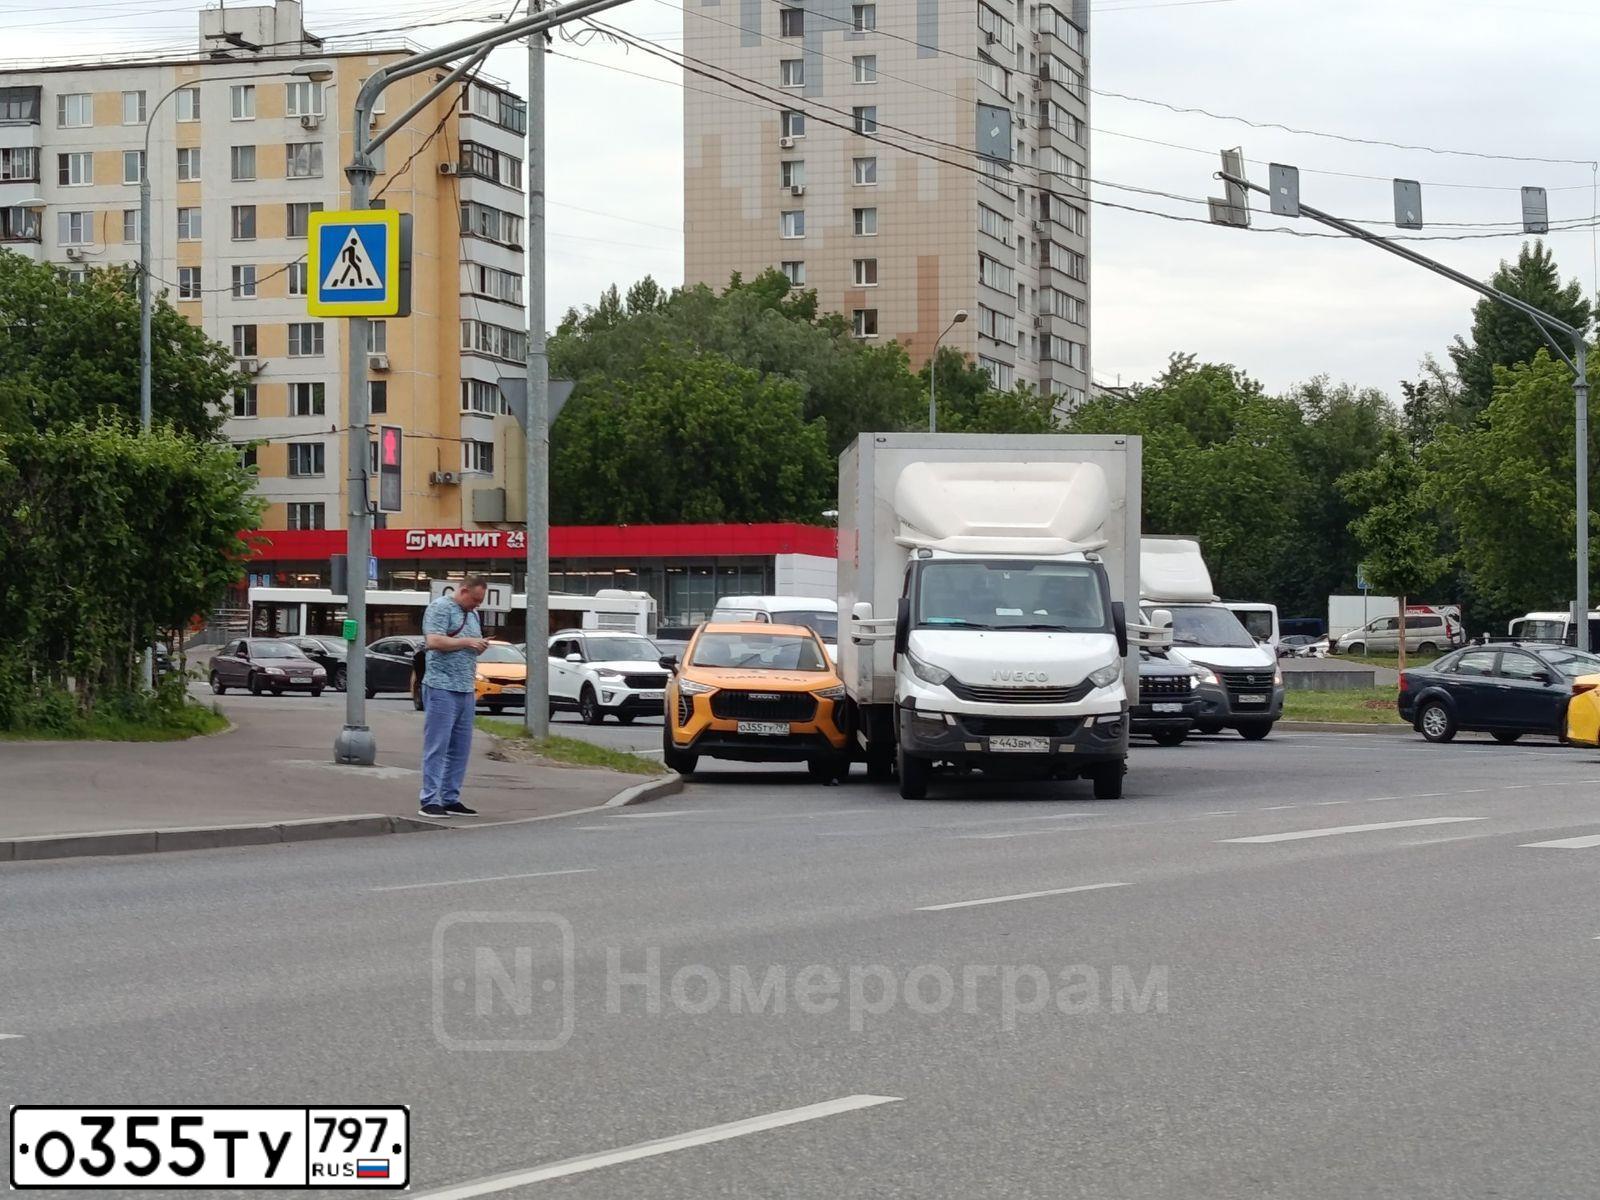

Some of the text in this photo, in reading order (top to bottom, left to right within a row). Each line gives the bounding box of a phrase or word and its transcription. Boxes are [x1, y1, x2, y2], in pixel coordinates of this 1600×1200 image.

[428, 533, 500, 548] МАГНИТ
[507, 531, 525, 543] 24
[442, 586, 500, 605] СП
[991, 669, 1049, 683] IVECO
